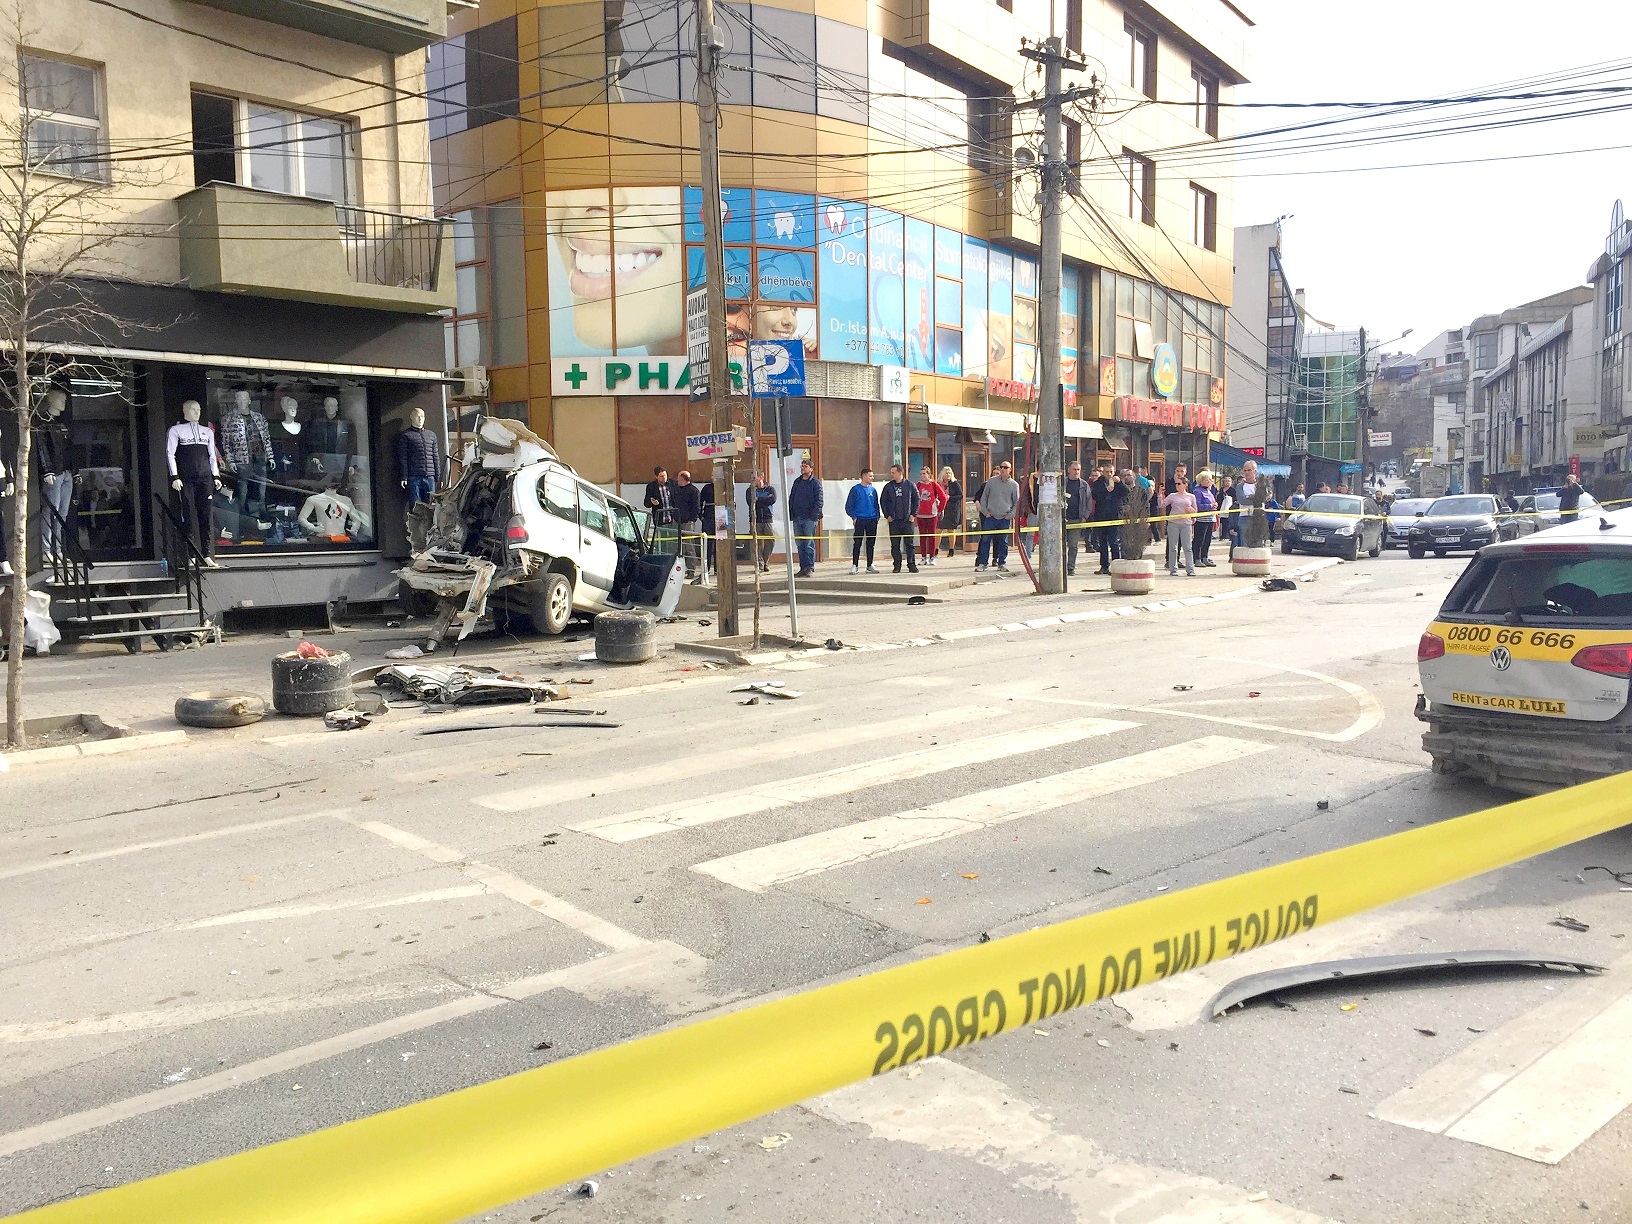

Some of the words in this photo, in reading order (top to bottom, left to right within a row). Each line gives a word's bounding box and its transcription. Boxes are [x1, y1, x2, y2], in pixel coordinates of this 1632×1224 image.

[760, 275, 812, 288] dhëmbëve
[845, 339, 868, 352] +377
[989, 377, 1035, 401] PIZZERIA
[686, 432, 735, 447] MOTEL
[1447, 626, 1491, 643] 0800
[1496, 629, 1524, 646] 66
[1530, 631, 1576, 650] 666
[1518, 699, 1566, 714] LULI
